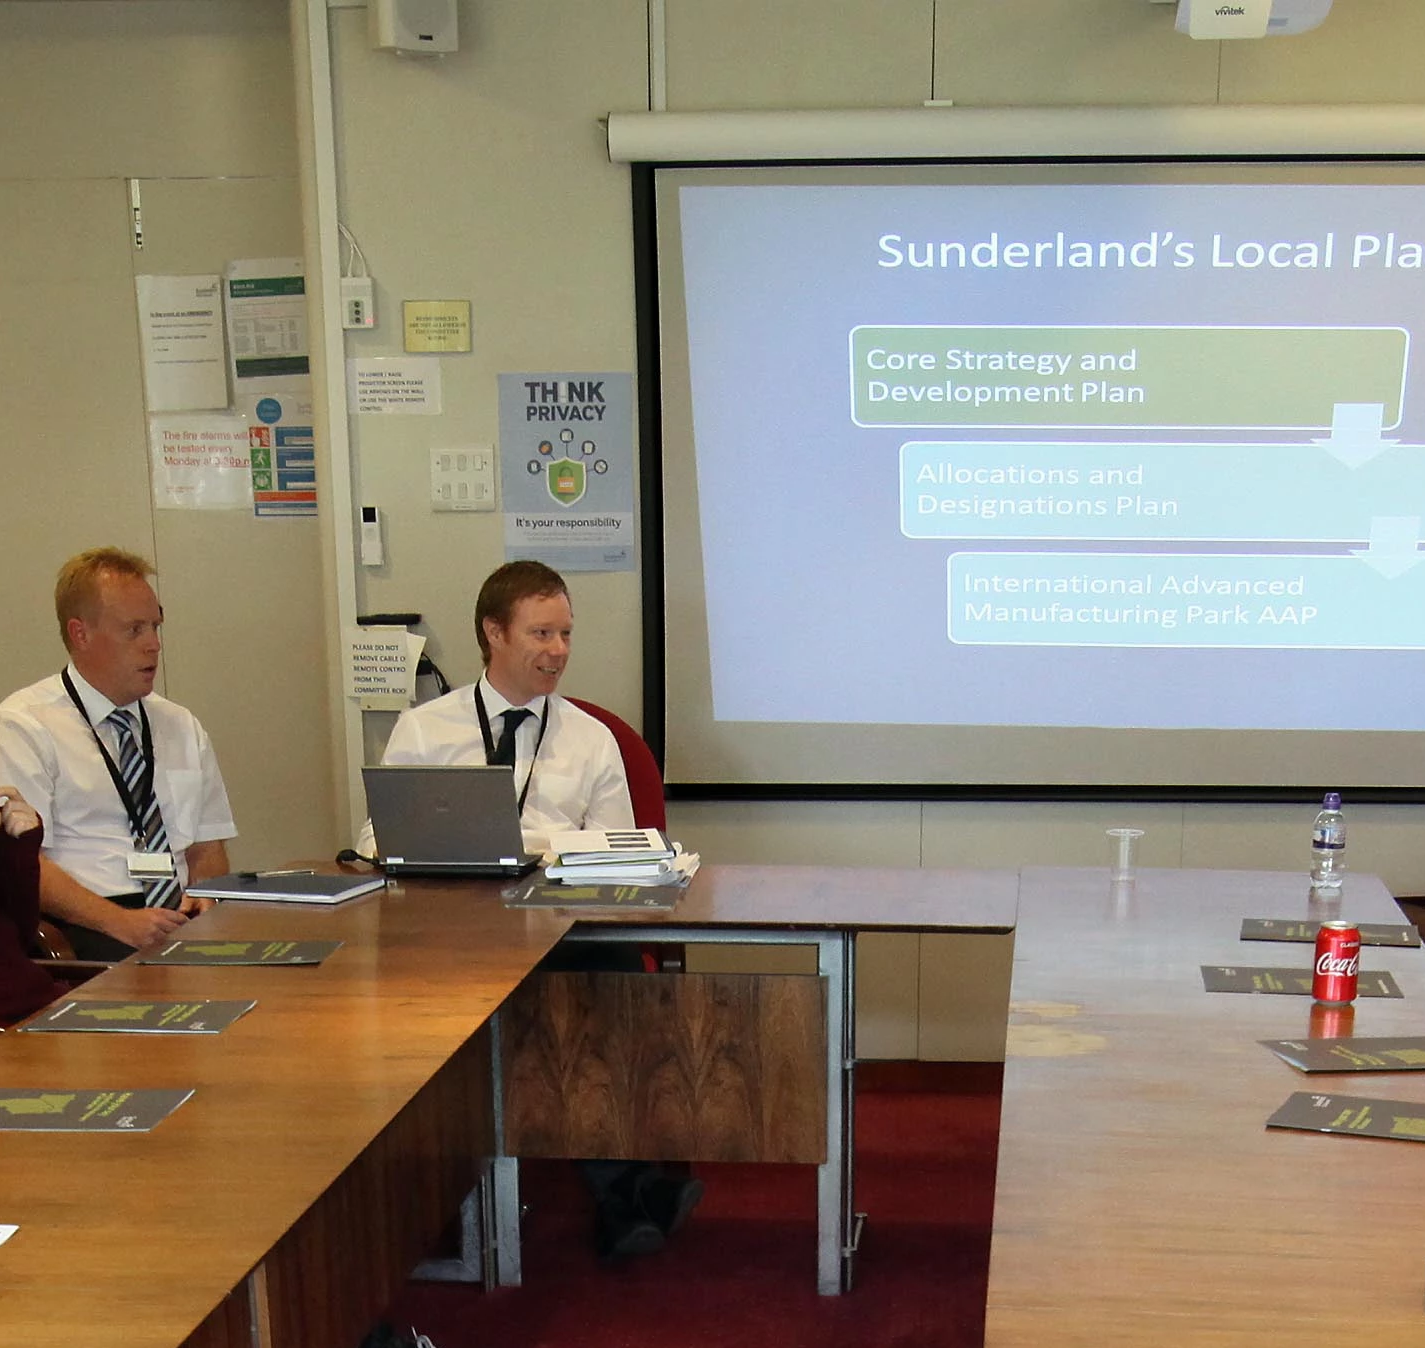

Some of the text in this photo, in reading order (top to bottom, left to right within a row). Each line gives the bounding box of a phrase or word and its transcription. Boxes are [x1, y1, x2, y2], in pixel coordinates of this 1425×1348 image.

[1215, 6, 1245, 16] vivitek
[877, 232, 1195, 268] Sunderland’s
[1210, 232, 1334, 268] Local
[866, 348, 1137, 376] Core Strategy and
[867, 380, 1145, 407] Development Plan
[526, 405, 607, 422] PRIVACY
[163, 431, 182, 441] The
[183, 431, 198, 441] fire
[199, 431, 230, 441] alarms
[163, 444, 175, 453] be
[178, 444, 206, 453] tested
[164, 456, 201, 467] Monday
[916, 463, 1144, 485] Allocations and
[917, 494, 1178, 519] Designations Plan
[516, 518, 622, 530] It's your responsibility
[965, 573, 1304, 597] International Advanced
[965, 603, 1318, 628] Manufacturing Park AAP
